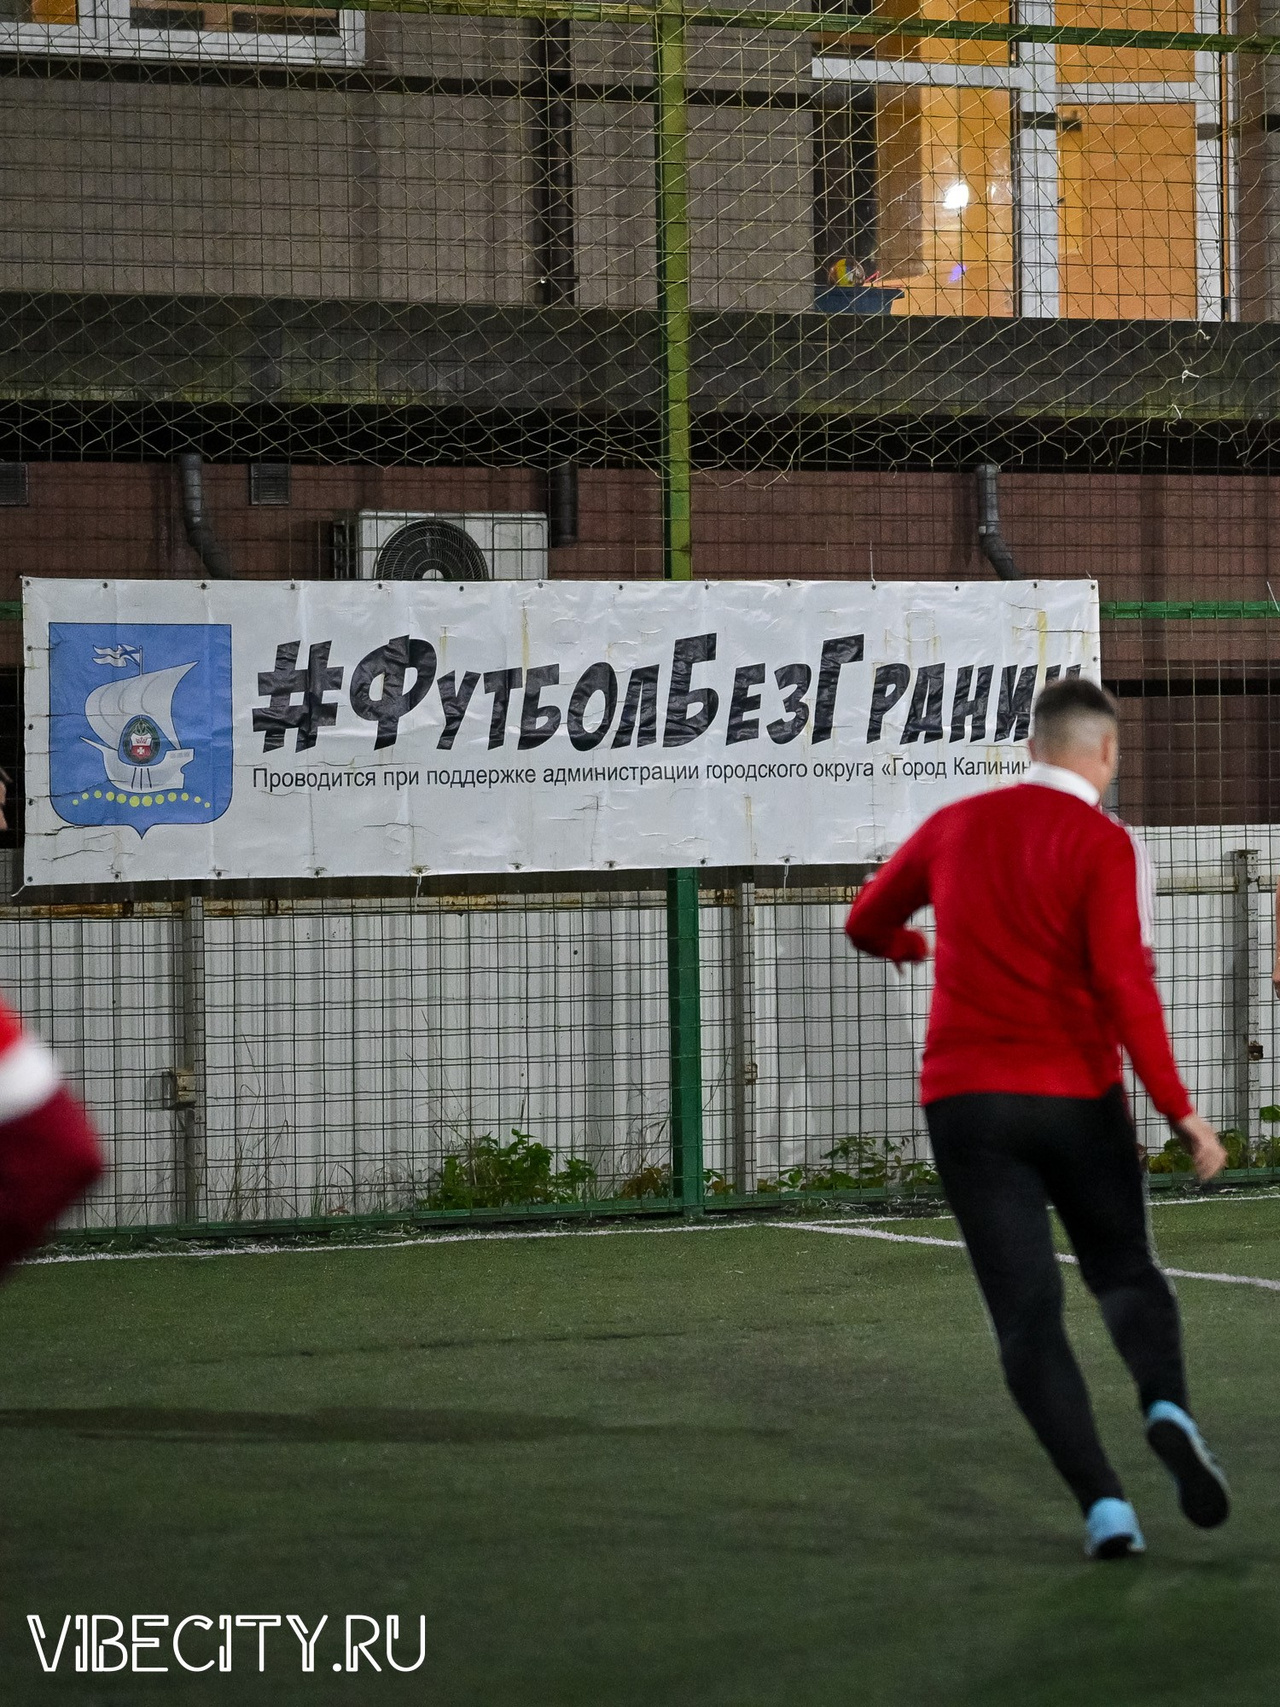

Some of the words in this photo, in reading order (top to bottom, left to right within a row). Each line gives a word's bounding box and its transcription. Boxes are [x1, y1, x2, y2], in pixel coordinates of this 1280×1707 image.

[252, 632, 1082, 754] #ФУТБОЛБЕЗГРАНИ
[253, 768, 376, 791] Проводится
[382, 771, 419, 790] при
[427, 768, 536, 789] поддержке
[543, 765, 698, 786] администрации
[706, 763, 807, 784] городского
[814, 763, 874, 783] округа
[882, 758, 947, 780] «Город
[954, 757, 1031, 776] Калинин
